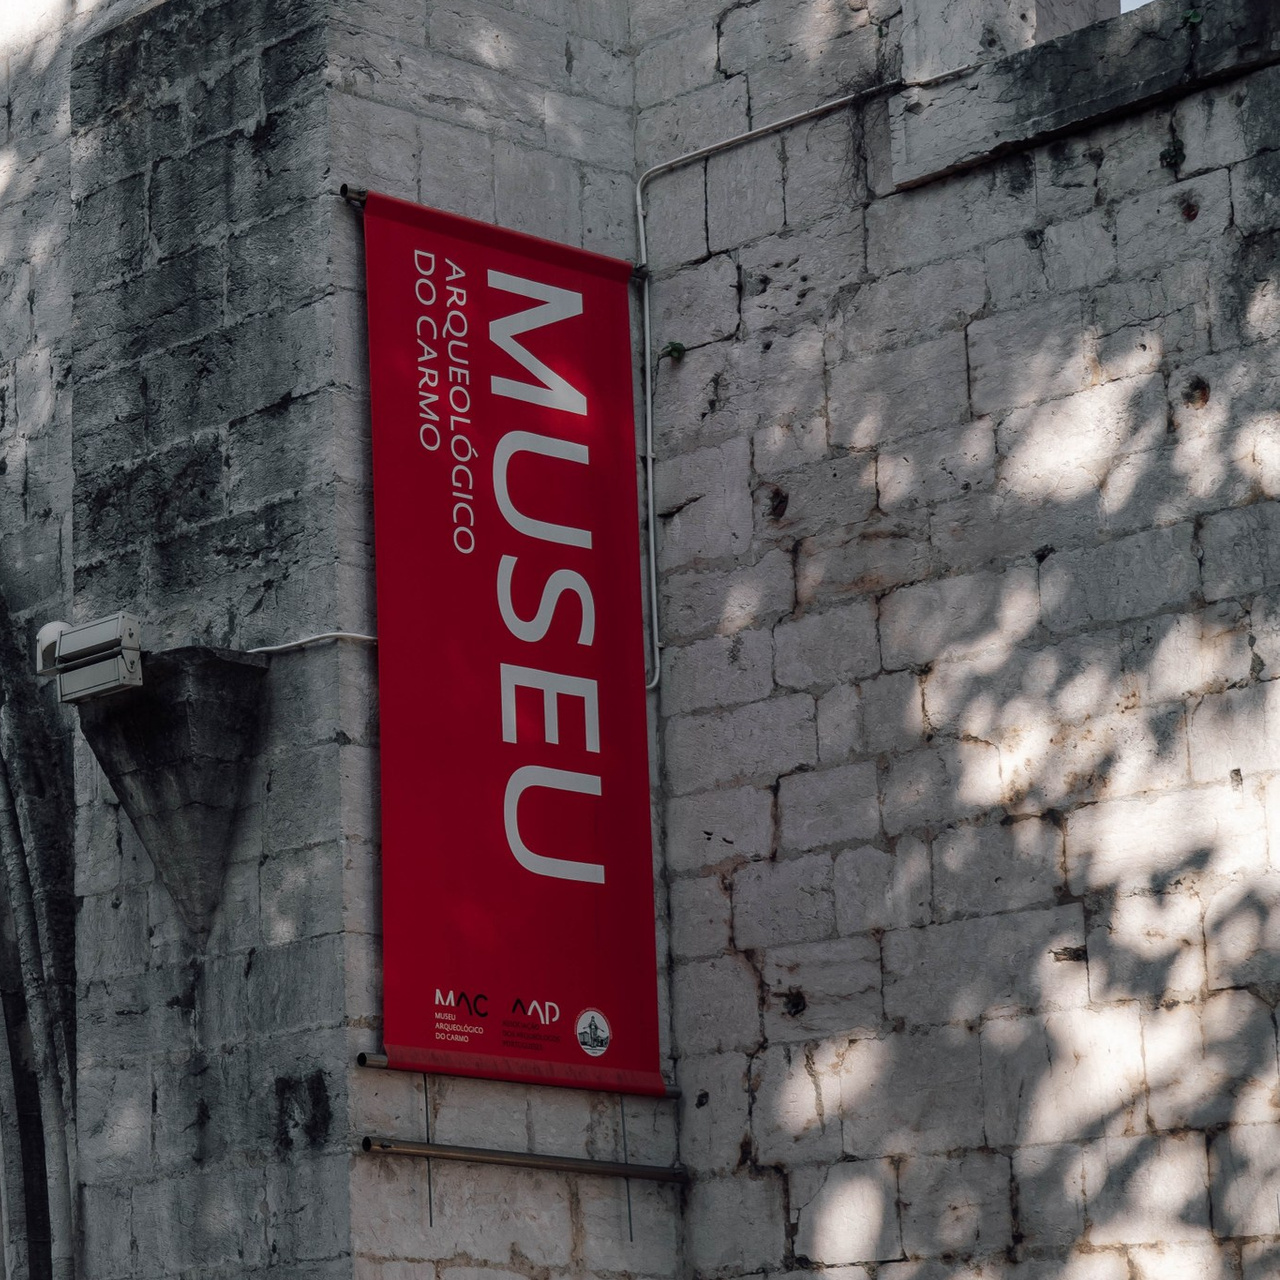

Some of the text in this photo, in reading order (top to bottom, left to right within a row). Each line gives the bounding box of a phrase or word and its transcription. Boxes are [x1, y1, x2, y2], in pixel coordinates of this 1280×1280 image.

[414, 249, 441, 451] DO CARMO
[444, 257, 479, 555] ARQUEOLÓGICO
[486, 268, 606, 885] MUSEU
[434, 988, 489, 1018] MAC
[434, 1012, 456, 1021] MUSEU
[435, 1022, 484, 1034] ARQUEOLÓGICO
[435, 1032, 469, 1043] DO CARMO
